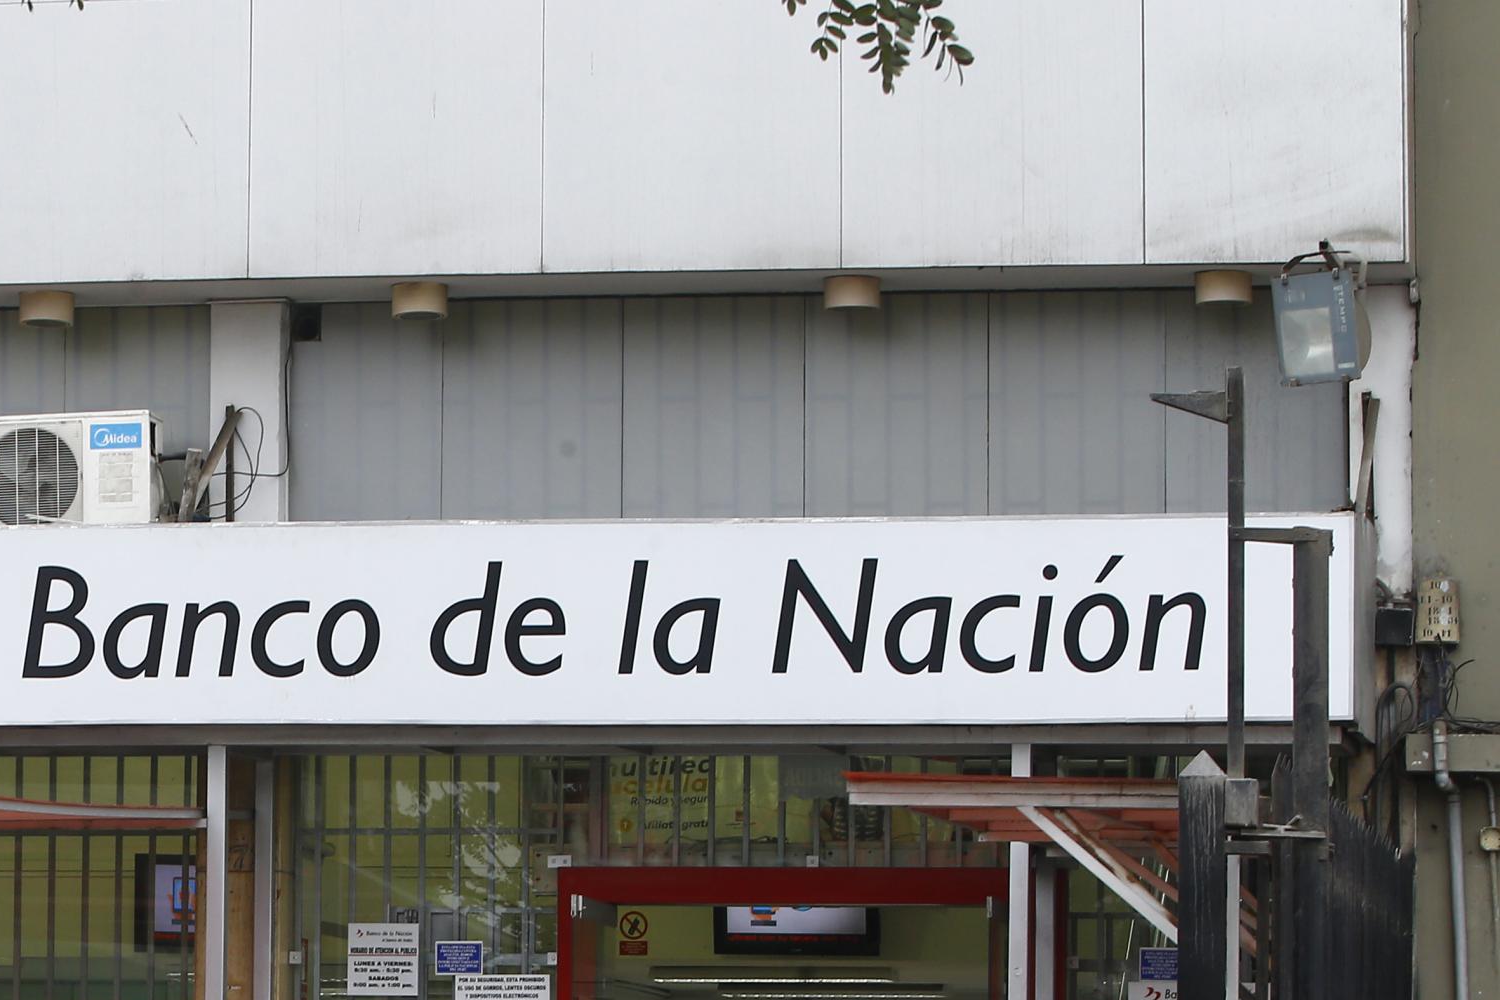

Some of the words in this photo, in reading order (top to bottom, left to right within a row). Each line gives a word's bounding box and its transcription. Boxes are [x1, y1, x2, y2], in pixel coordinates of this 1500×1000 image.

[99, 431, 138, 445] Midea
[22, 565, 381, 679] Banco
[430, 561, 566, 677] de
[618, 560, 721, 675] la
[772, 555, 1207, 674] Nación
